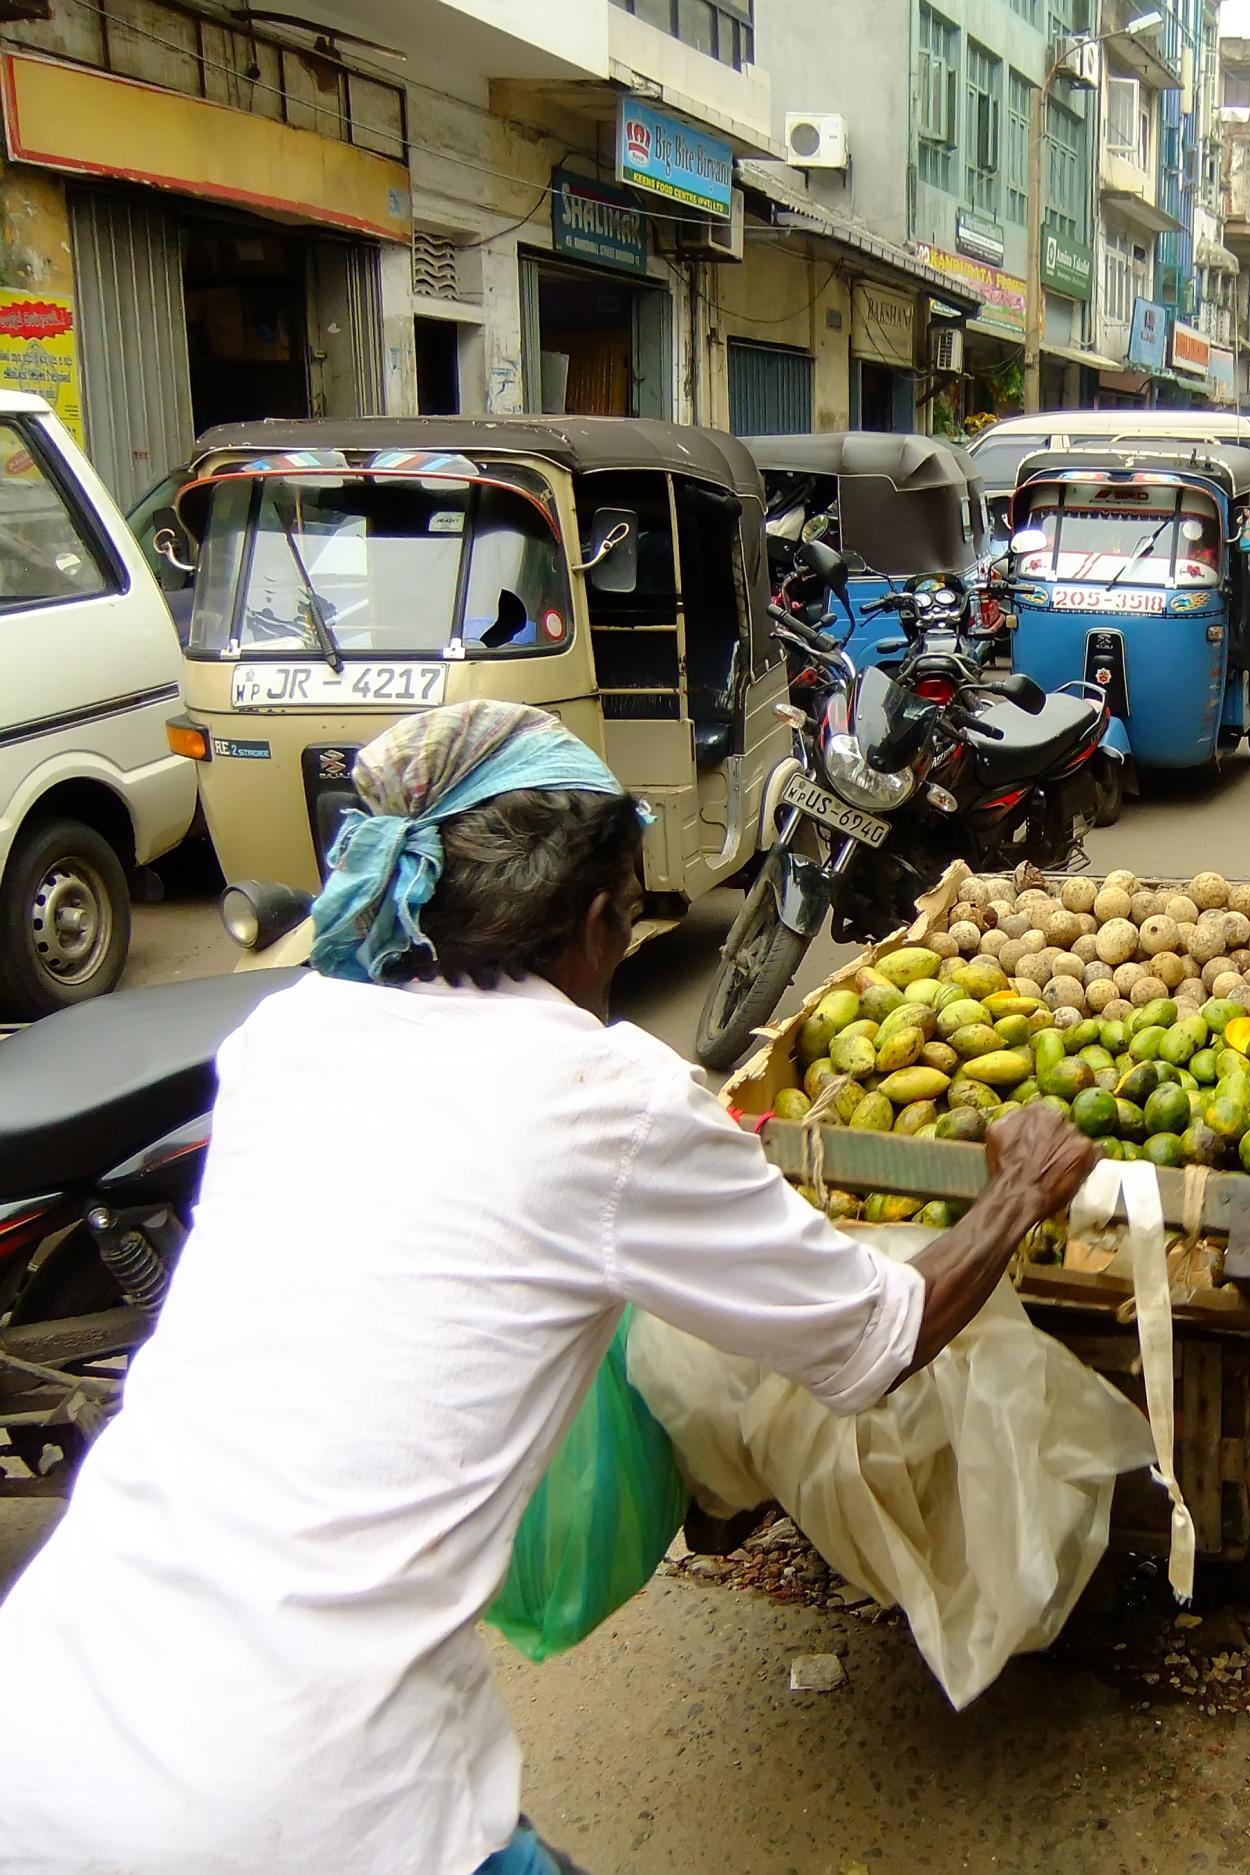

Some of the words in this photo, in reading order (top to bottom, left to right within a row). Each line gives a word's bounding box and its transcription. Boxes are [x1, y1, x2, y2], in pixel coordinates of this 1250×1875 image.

[655, 125, 672, 177] Big
[674, 134, 695, 173] Bite
[656, 180, 674, 196] FOOD
[562, 183, 641, 249] SHALIMAR
[214, 740, 230, 756] RE
[805, 789, 885, 844] US-6940
